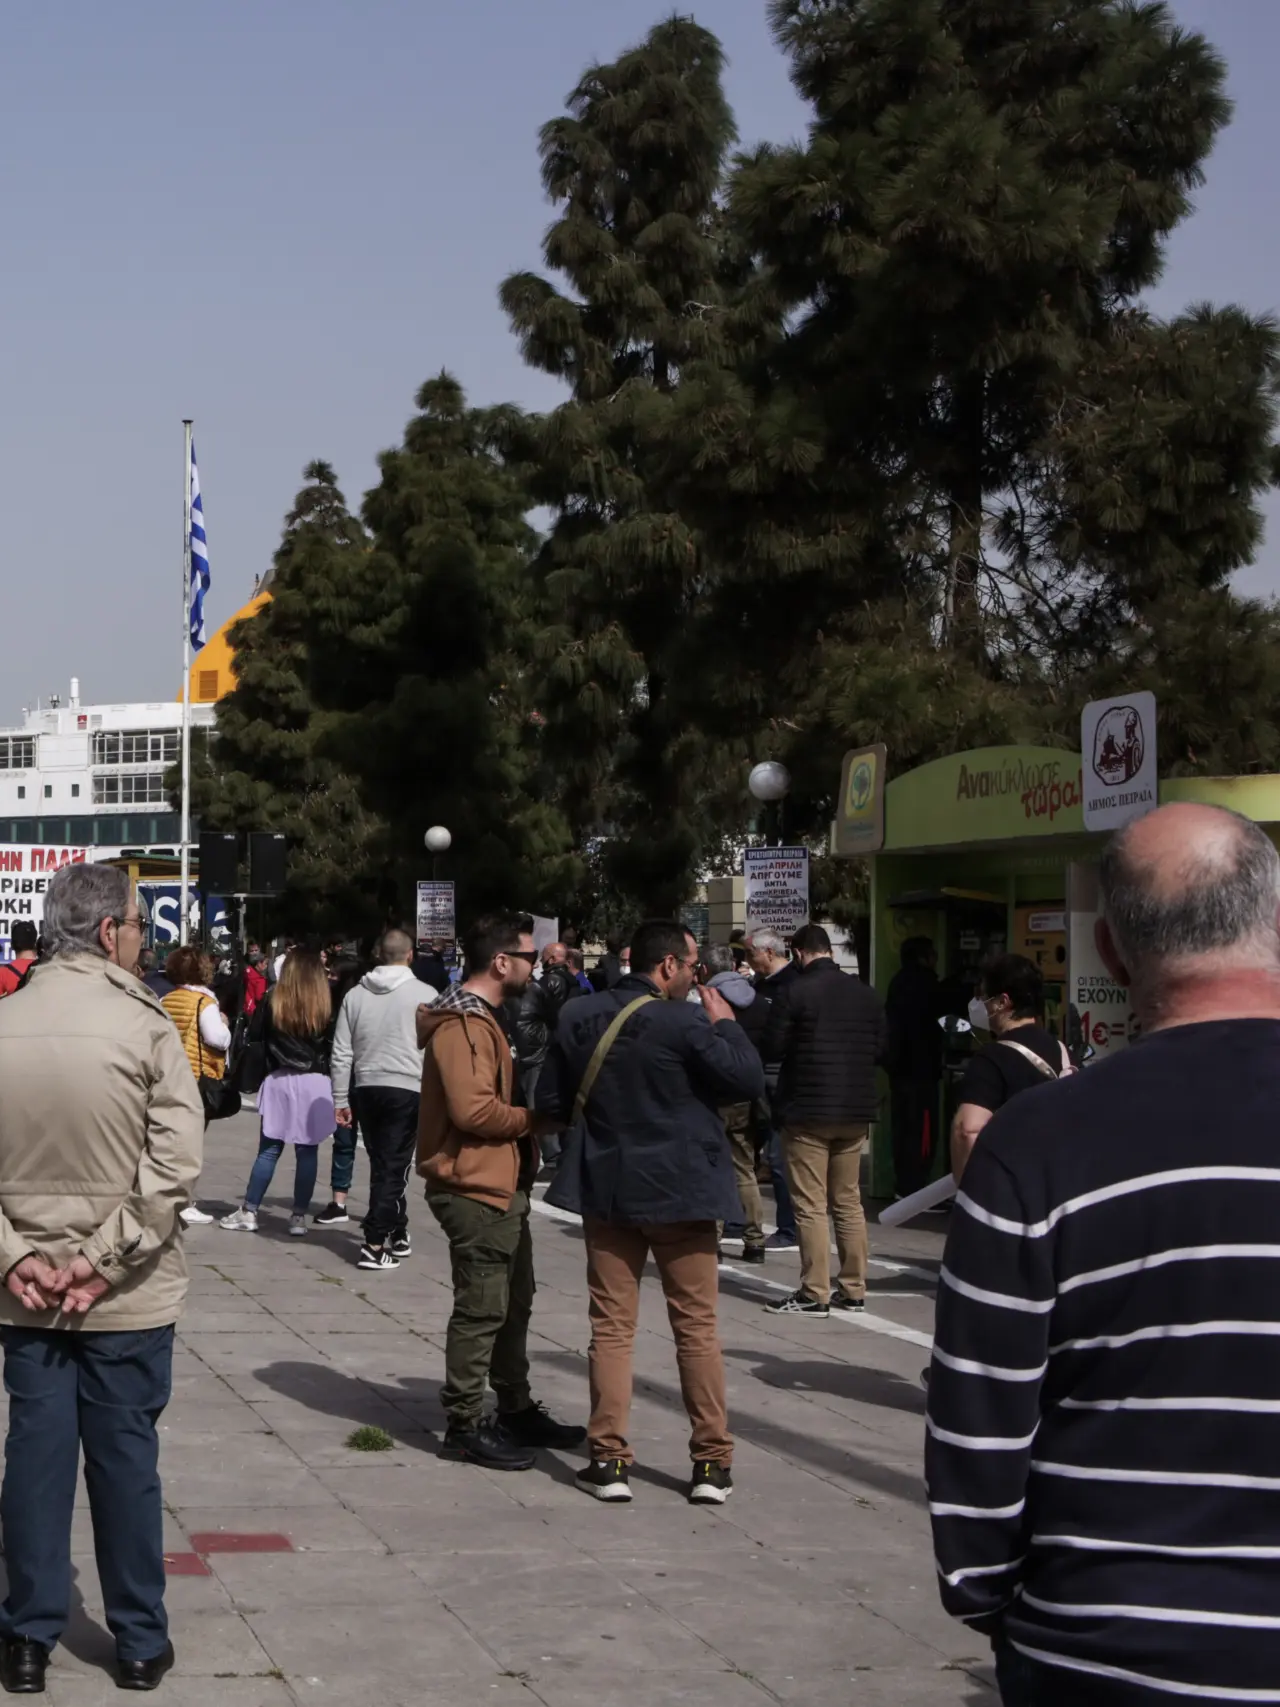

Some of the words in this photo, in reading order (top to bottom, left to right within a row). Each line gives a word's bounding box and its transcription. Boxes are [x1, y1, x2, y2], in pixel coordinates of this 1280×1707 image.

[1088, 795, 1117, 811] ΔΗΜΟΣ
[1119, 789, 1152, 807] ΠΕΙΡΑΙΑ
[1078, 988, 1127, 1004] ΕΧΟΥΝ
